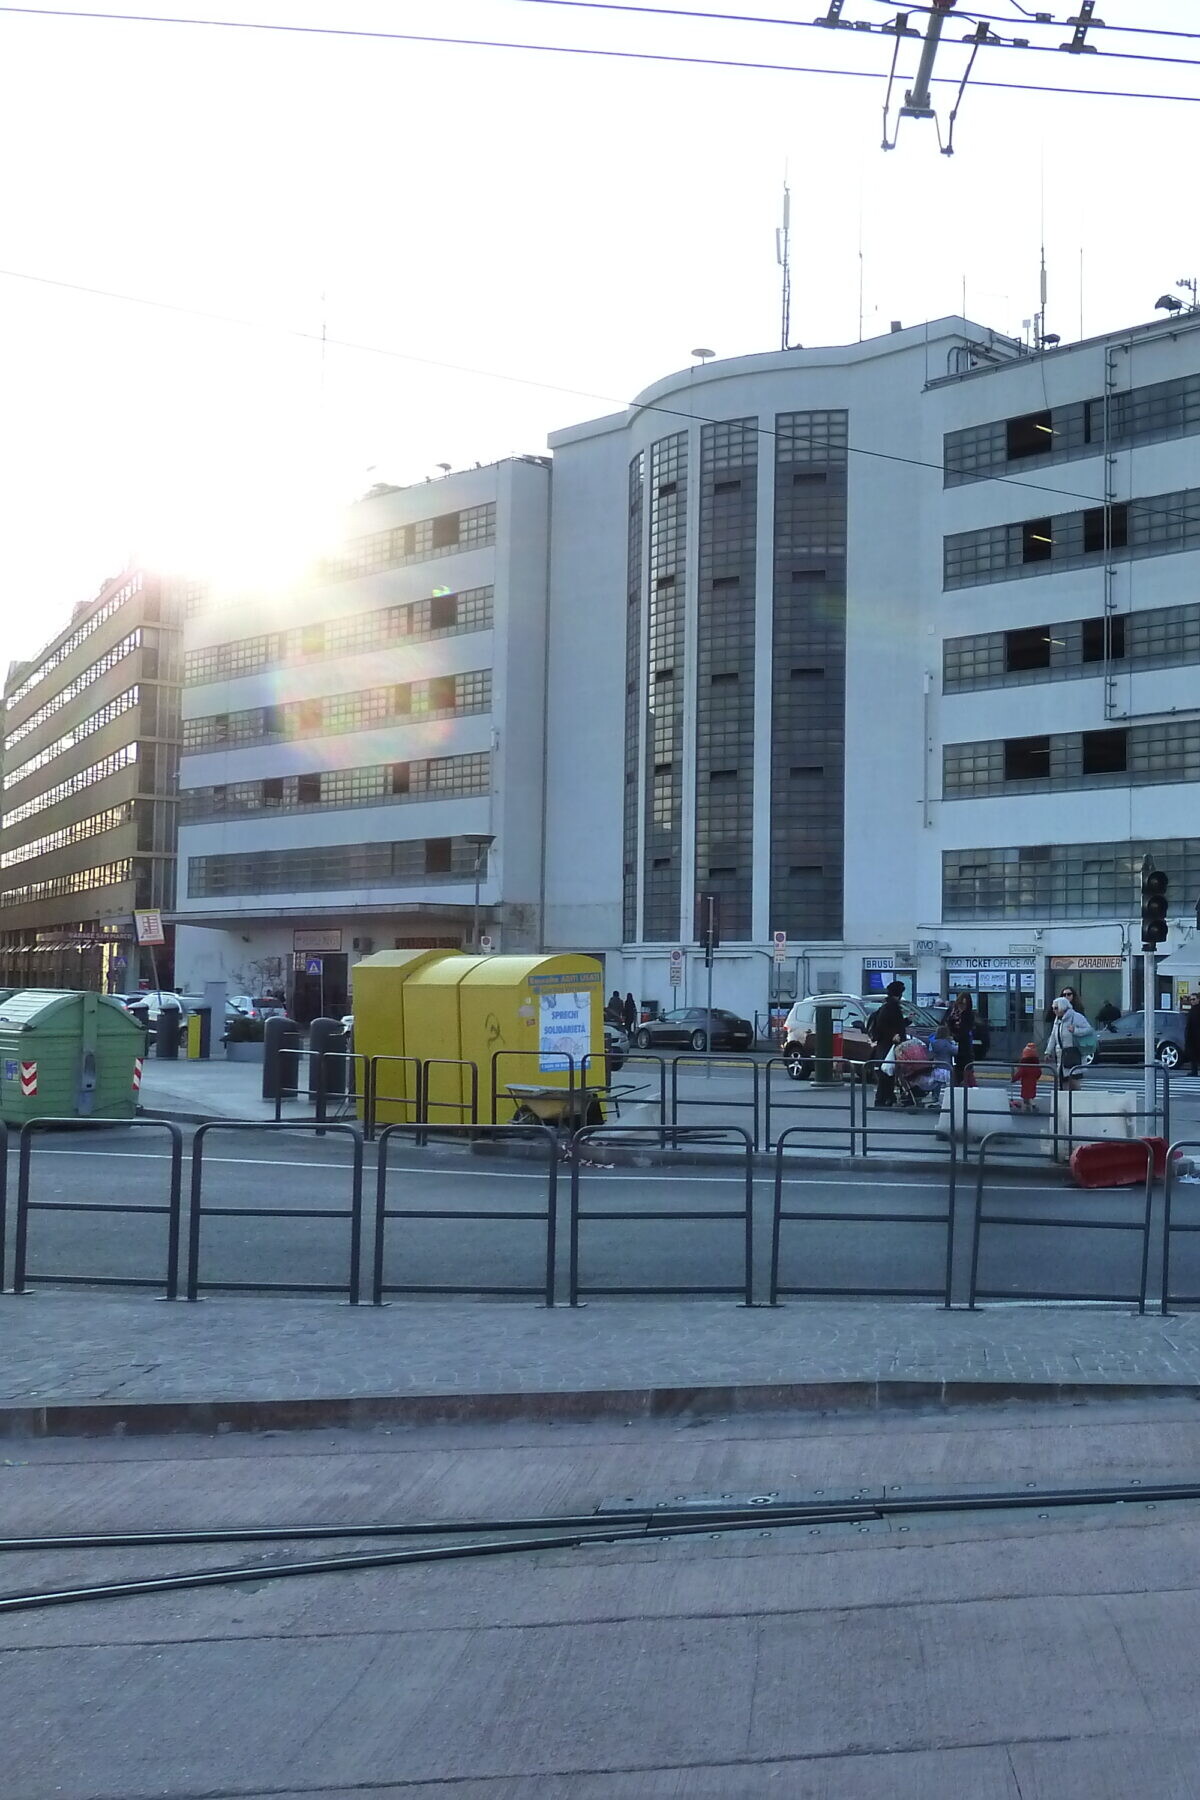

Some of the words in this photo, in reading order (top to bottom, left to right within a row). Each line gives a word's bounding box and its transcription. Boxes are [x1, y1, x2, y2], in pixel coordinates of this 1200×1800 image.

[965, 958, 991, 968] TICKET
[993, 958, 1021, 968] OFFICE
[1077, 958, 1122, 968] CARABINIERI
